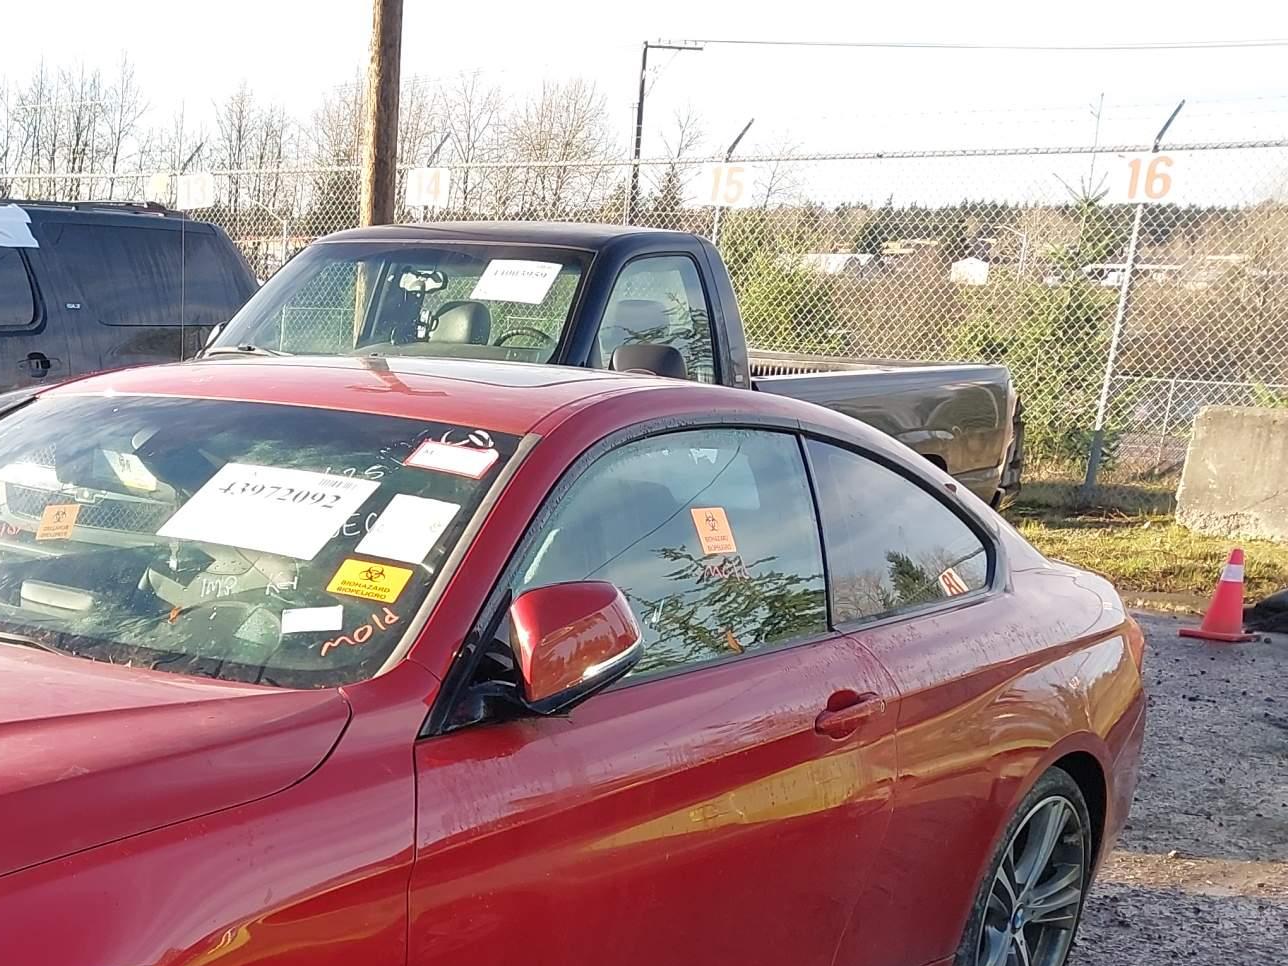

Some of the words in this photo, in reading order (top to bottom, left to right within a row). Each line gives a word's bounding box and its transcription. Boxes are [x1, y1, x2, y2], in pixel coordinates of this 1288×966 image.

[711, 166, 745, 204] 15
[1127, 156, 1174, 200] 16
[218, 481, 343, 510] 43972092
[335, 585, 387, 600] BIOPELIGRO
[339, 579, 391, 594] BIOHAZARD
[320, 607, 400, 656] mold
